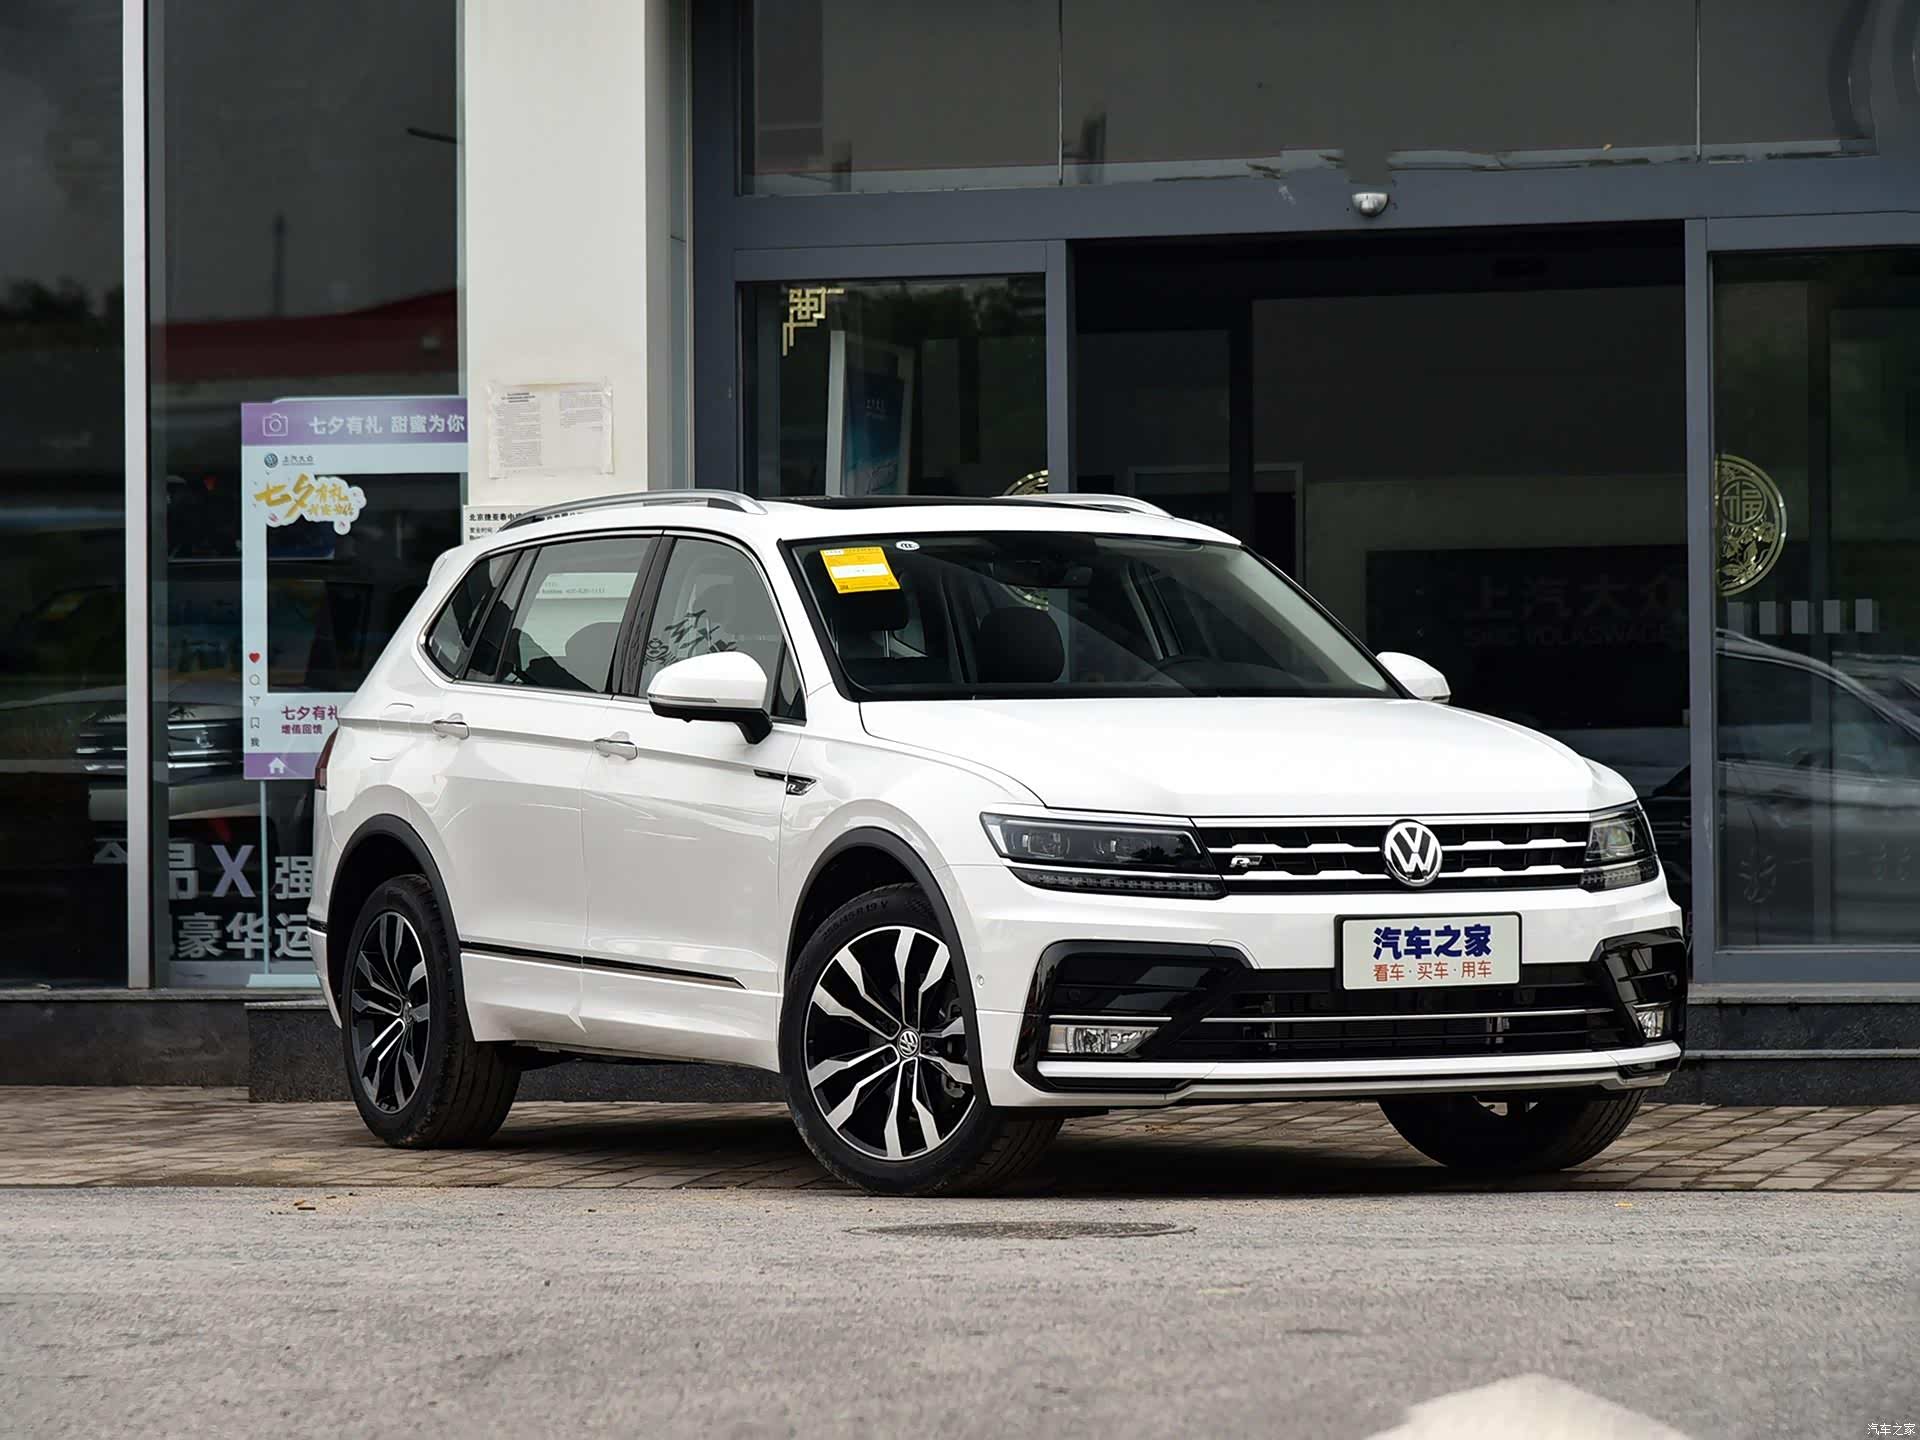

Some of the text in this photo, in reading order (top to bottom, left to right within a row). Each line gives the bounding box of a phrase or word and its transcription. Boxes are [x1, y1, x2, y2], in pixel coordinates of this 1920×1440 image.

[308, 414, 465, 435] 七夕有礼 甜蜜为你
[168, 912, 312, 959] 豪华运
[1373, 923, 1492, 960] 汽车之家
